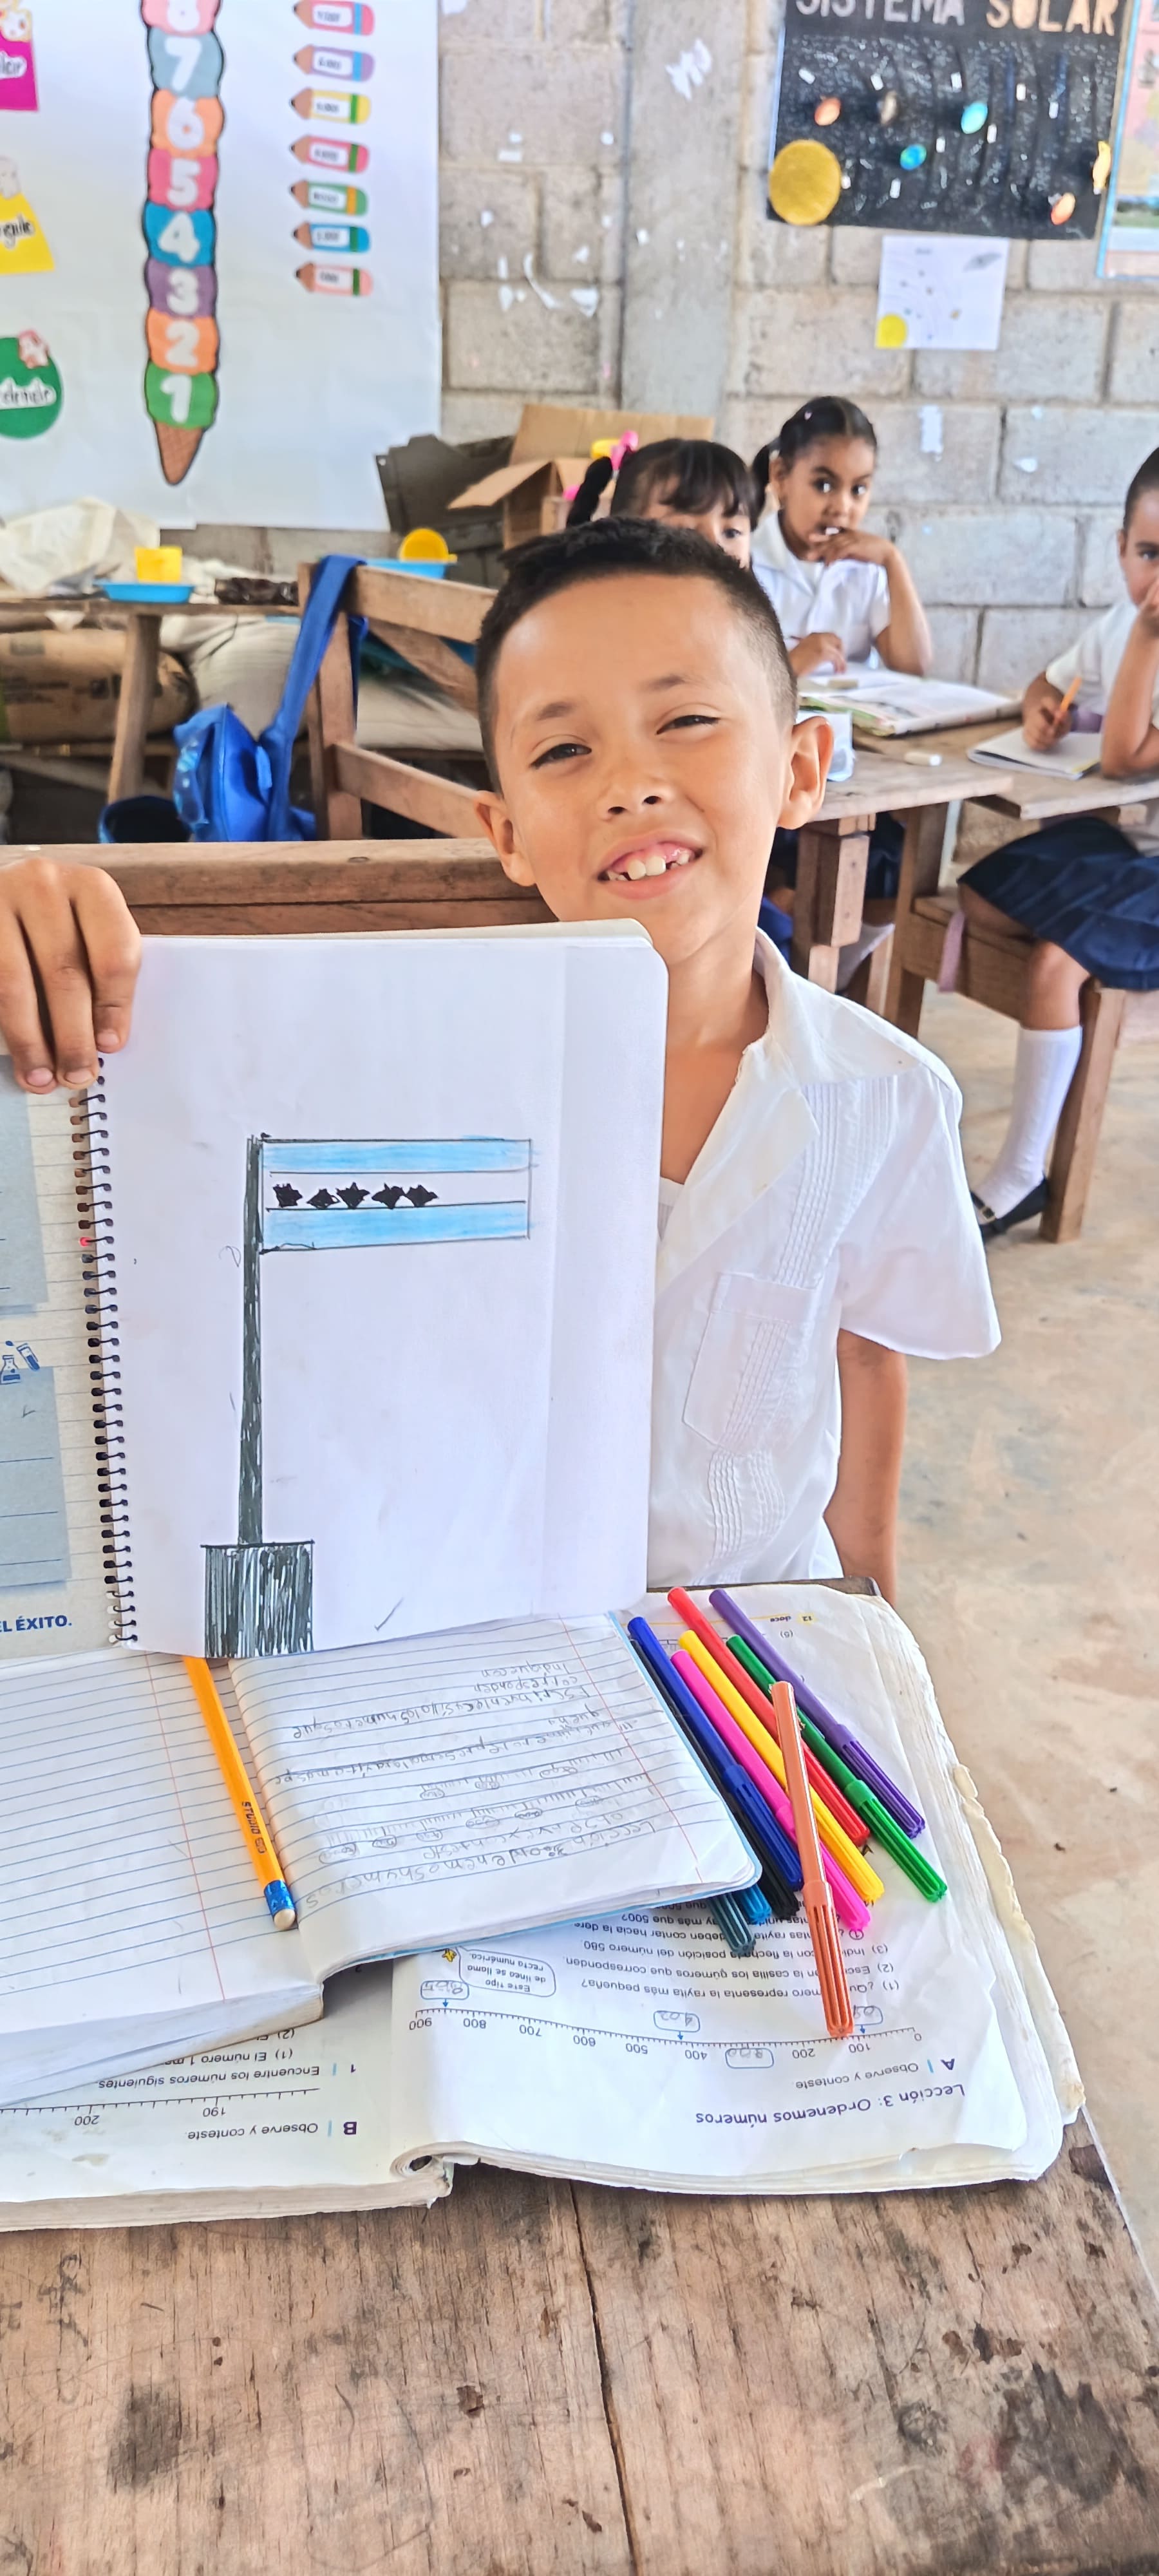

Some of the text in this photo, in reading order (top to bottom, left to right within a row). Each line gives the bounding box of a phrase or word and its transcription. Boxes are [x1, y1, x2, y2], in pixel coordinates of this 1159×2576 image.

[164, 37, 202, 93] 7
[165, 99, 203, 148] 6
[166, 158, 200, 207] 5
[158, 213, 200, 262] 4
[166, 269, 200, 316] 3
[165, 324, 200, 366] 2
[161, 374, 193, 422] 1
[15, 1615, 72, 1631] ÉXITO.
[621, 1913, 649, 1923] 500?
[652, 1916, 674, 1924] que
[603, 1925, 612, 1934] la
[616, 1927, 646, 1936] hacia
[650, 1930, 686, 1940] contar
[690, 1932, 724, 1942] deben
[609, 1944, 653, 1956] número
[678, 1948, 726, 1960] posición
[782, 1951, 793, 1960] la
[467, 1965, 492, 1976] llama
[518, 1960, 543, 1971] recta
[650, 1966, 672, 1975] que
[877, 1962, 894, 1973] (2)
[509, 1971, 531, 1983] línea
[731, 1971, 748, 1979] los
[752, 1970, 789, 1980] casilla
[793, 1970, 803, 1978] la
[485, 1978, 531, 1993] Este tipo
[581, 1979, 639, 1993] pequeña?
[644, 1985, 668, 1996] más
[849, 1981, 874, 1993] ¿Qu
[673, 1987, 705, 1998] rayita
[710, 1990, 720, 1998] la
[724, 1987, 788, 1999] representa
[409, 2018, 707, 2060] 400 500 600 700 800 900
[792, 2048, 815, 2059] 200
[849, 2043, 871, 2053] 100
[200, 2053, 250, 2065] número
[254, 2050, 267, 2062] El
[275, 2049, 292, 2060] (1)
[350, 2064, 357, 2073] 1
[865, 2062, 919, 2080] Observe
[941, 2059, 956, 2071] A
[230, 2070, 249, 2082] los
[253, 2065, 319, 2081] Encuentre
[854, 2072, 861, 2082] y
[169, 2072, 227, 2087] números
[899, 2083, 965, 2103] Lección
[74, 2106, 225, 2126] 190 200
[773, 2098, 871, 2124] Ordenemos
[695, 2112, 767, 2128] números
[249, 2125, 257, 2137] y
[261, 2123, 318, 2136] Observe
[343, 2121, 357, 2135] B
